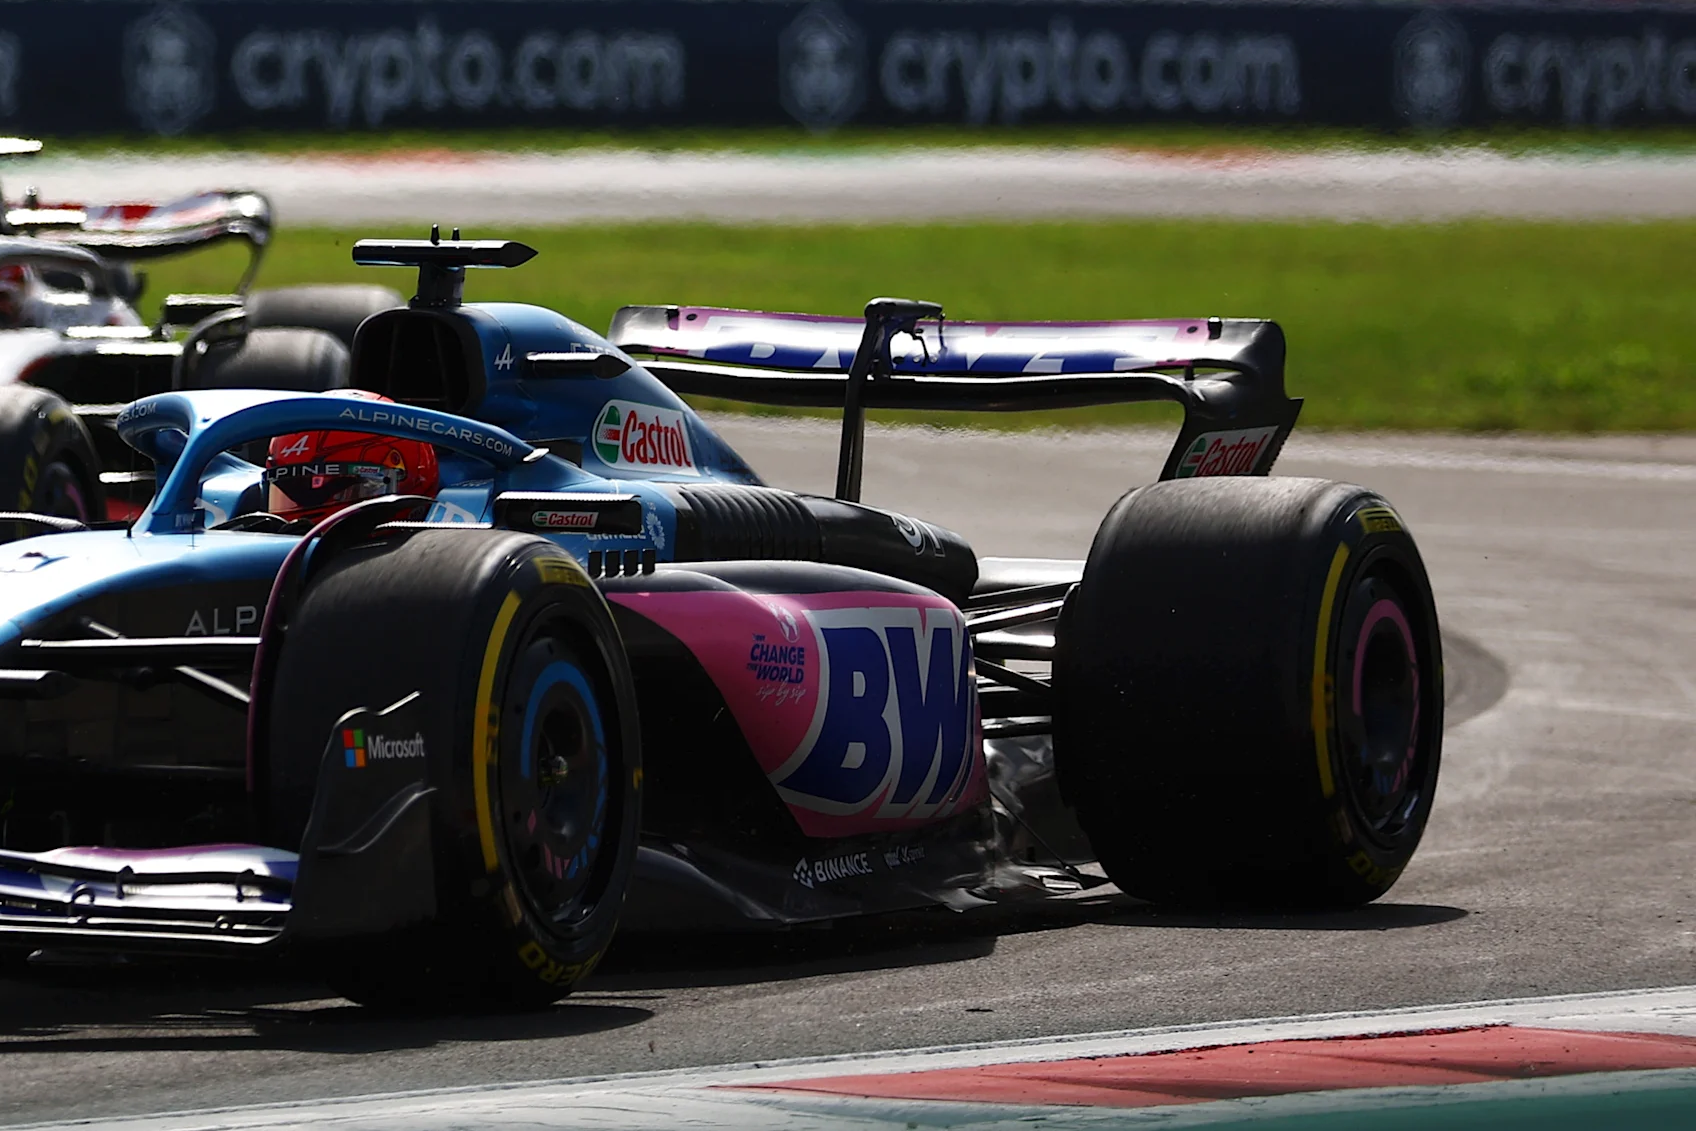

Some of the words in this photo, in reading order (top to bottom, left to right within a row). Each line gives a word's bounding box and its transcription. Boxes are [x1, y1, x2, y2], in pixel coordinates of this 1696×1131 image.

[230, 16, 686, 128] crypto.com
[879, 16, 1302, 128] crypto.com
[339, 407, 513, 458] ALPINECARS.COM
[621, 410, 692, 468] Castrol
[266, 463, 340, 482] LPINE
[548, 512, 594, 527] Castrol
[184, 605, 257, 636] ALP
[750, 643, 805, 666] CHANGE
[755, 663, 805, 684] WORLD
[777, 627, 974, 804] BW
[367, 731, 425, 759] Microsoft
[813, 851, 873, 883] BINANCE
